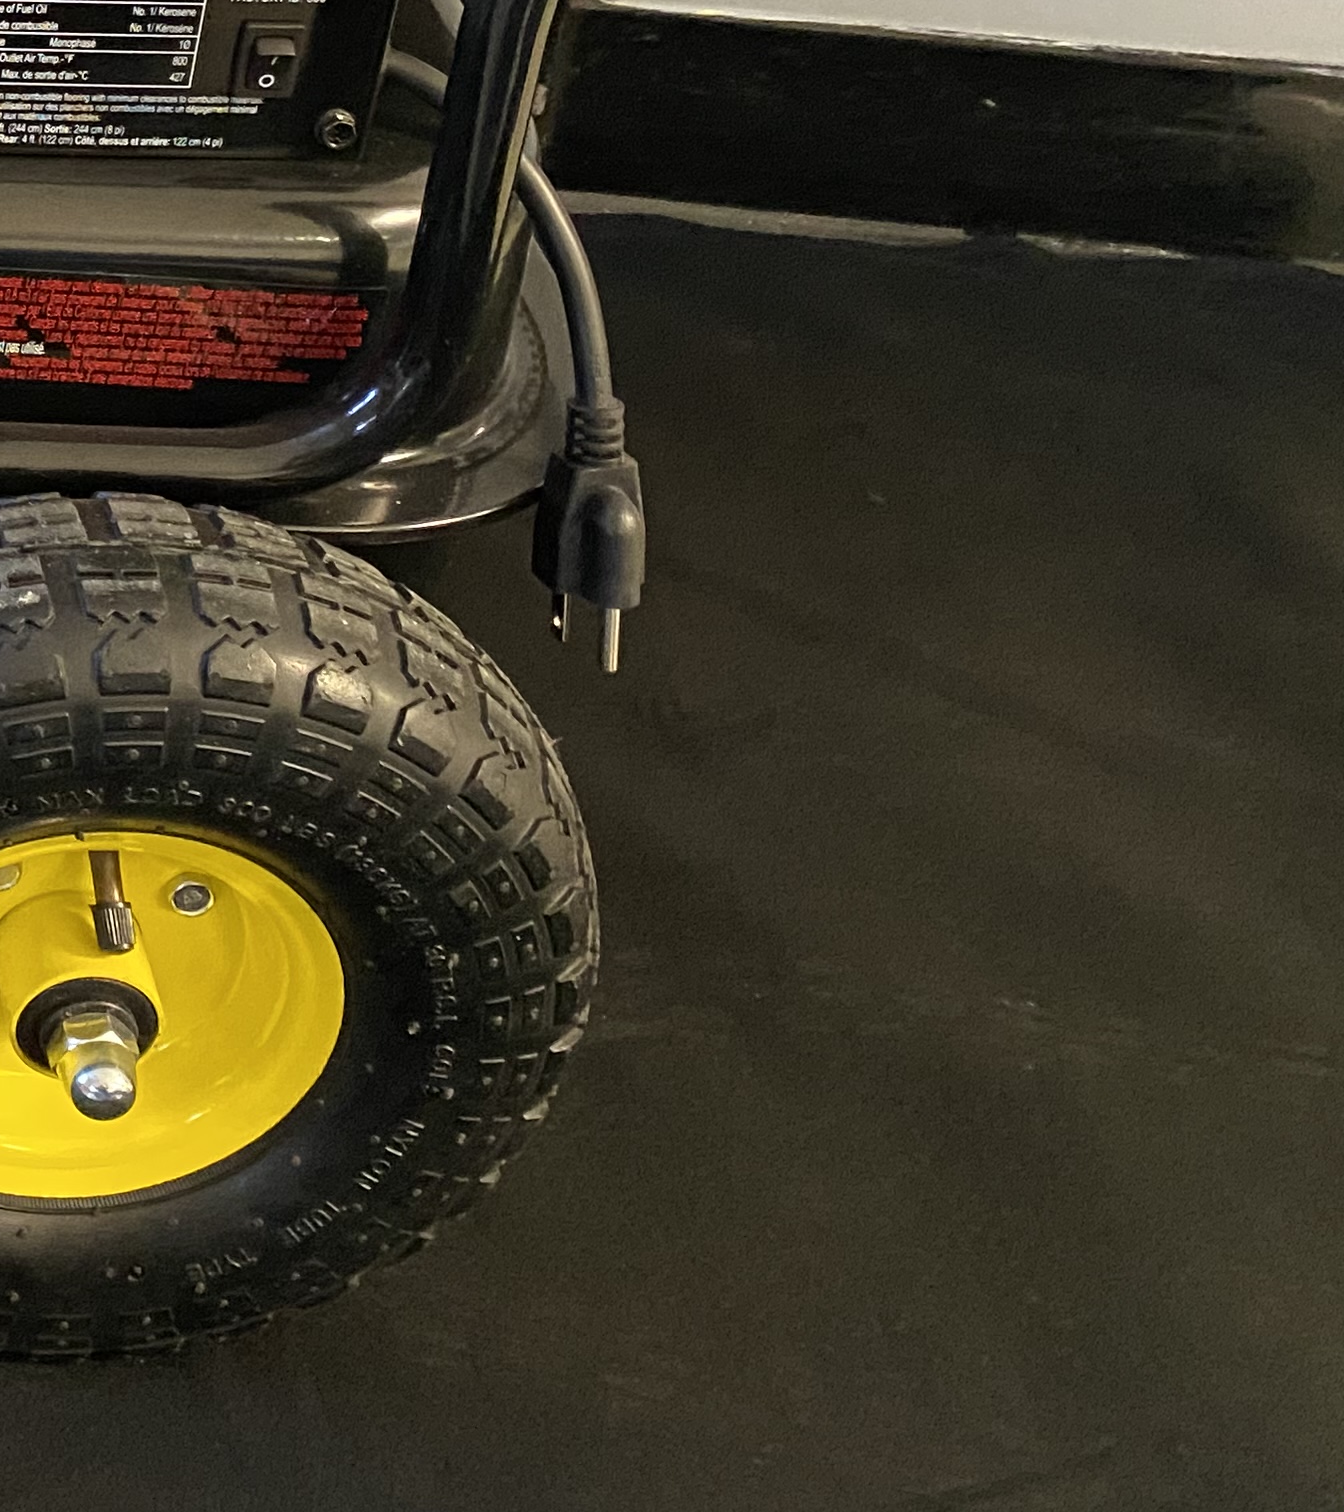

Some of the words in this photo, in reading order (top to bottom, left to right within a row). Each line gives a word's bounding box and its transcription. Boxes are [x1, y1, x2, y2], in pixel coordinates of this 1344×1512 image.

[6, 4, 15, 14] of
[16, 4, 34, 15] Fuel
[36, 4, 48, 15] Oil
[172, 56, 188, 66] 800
